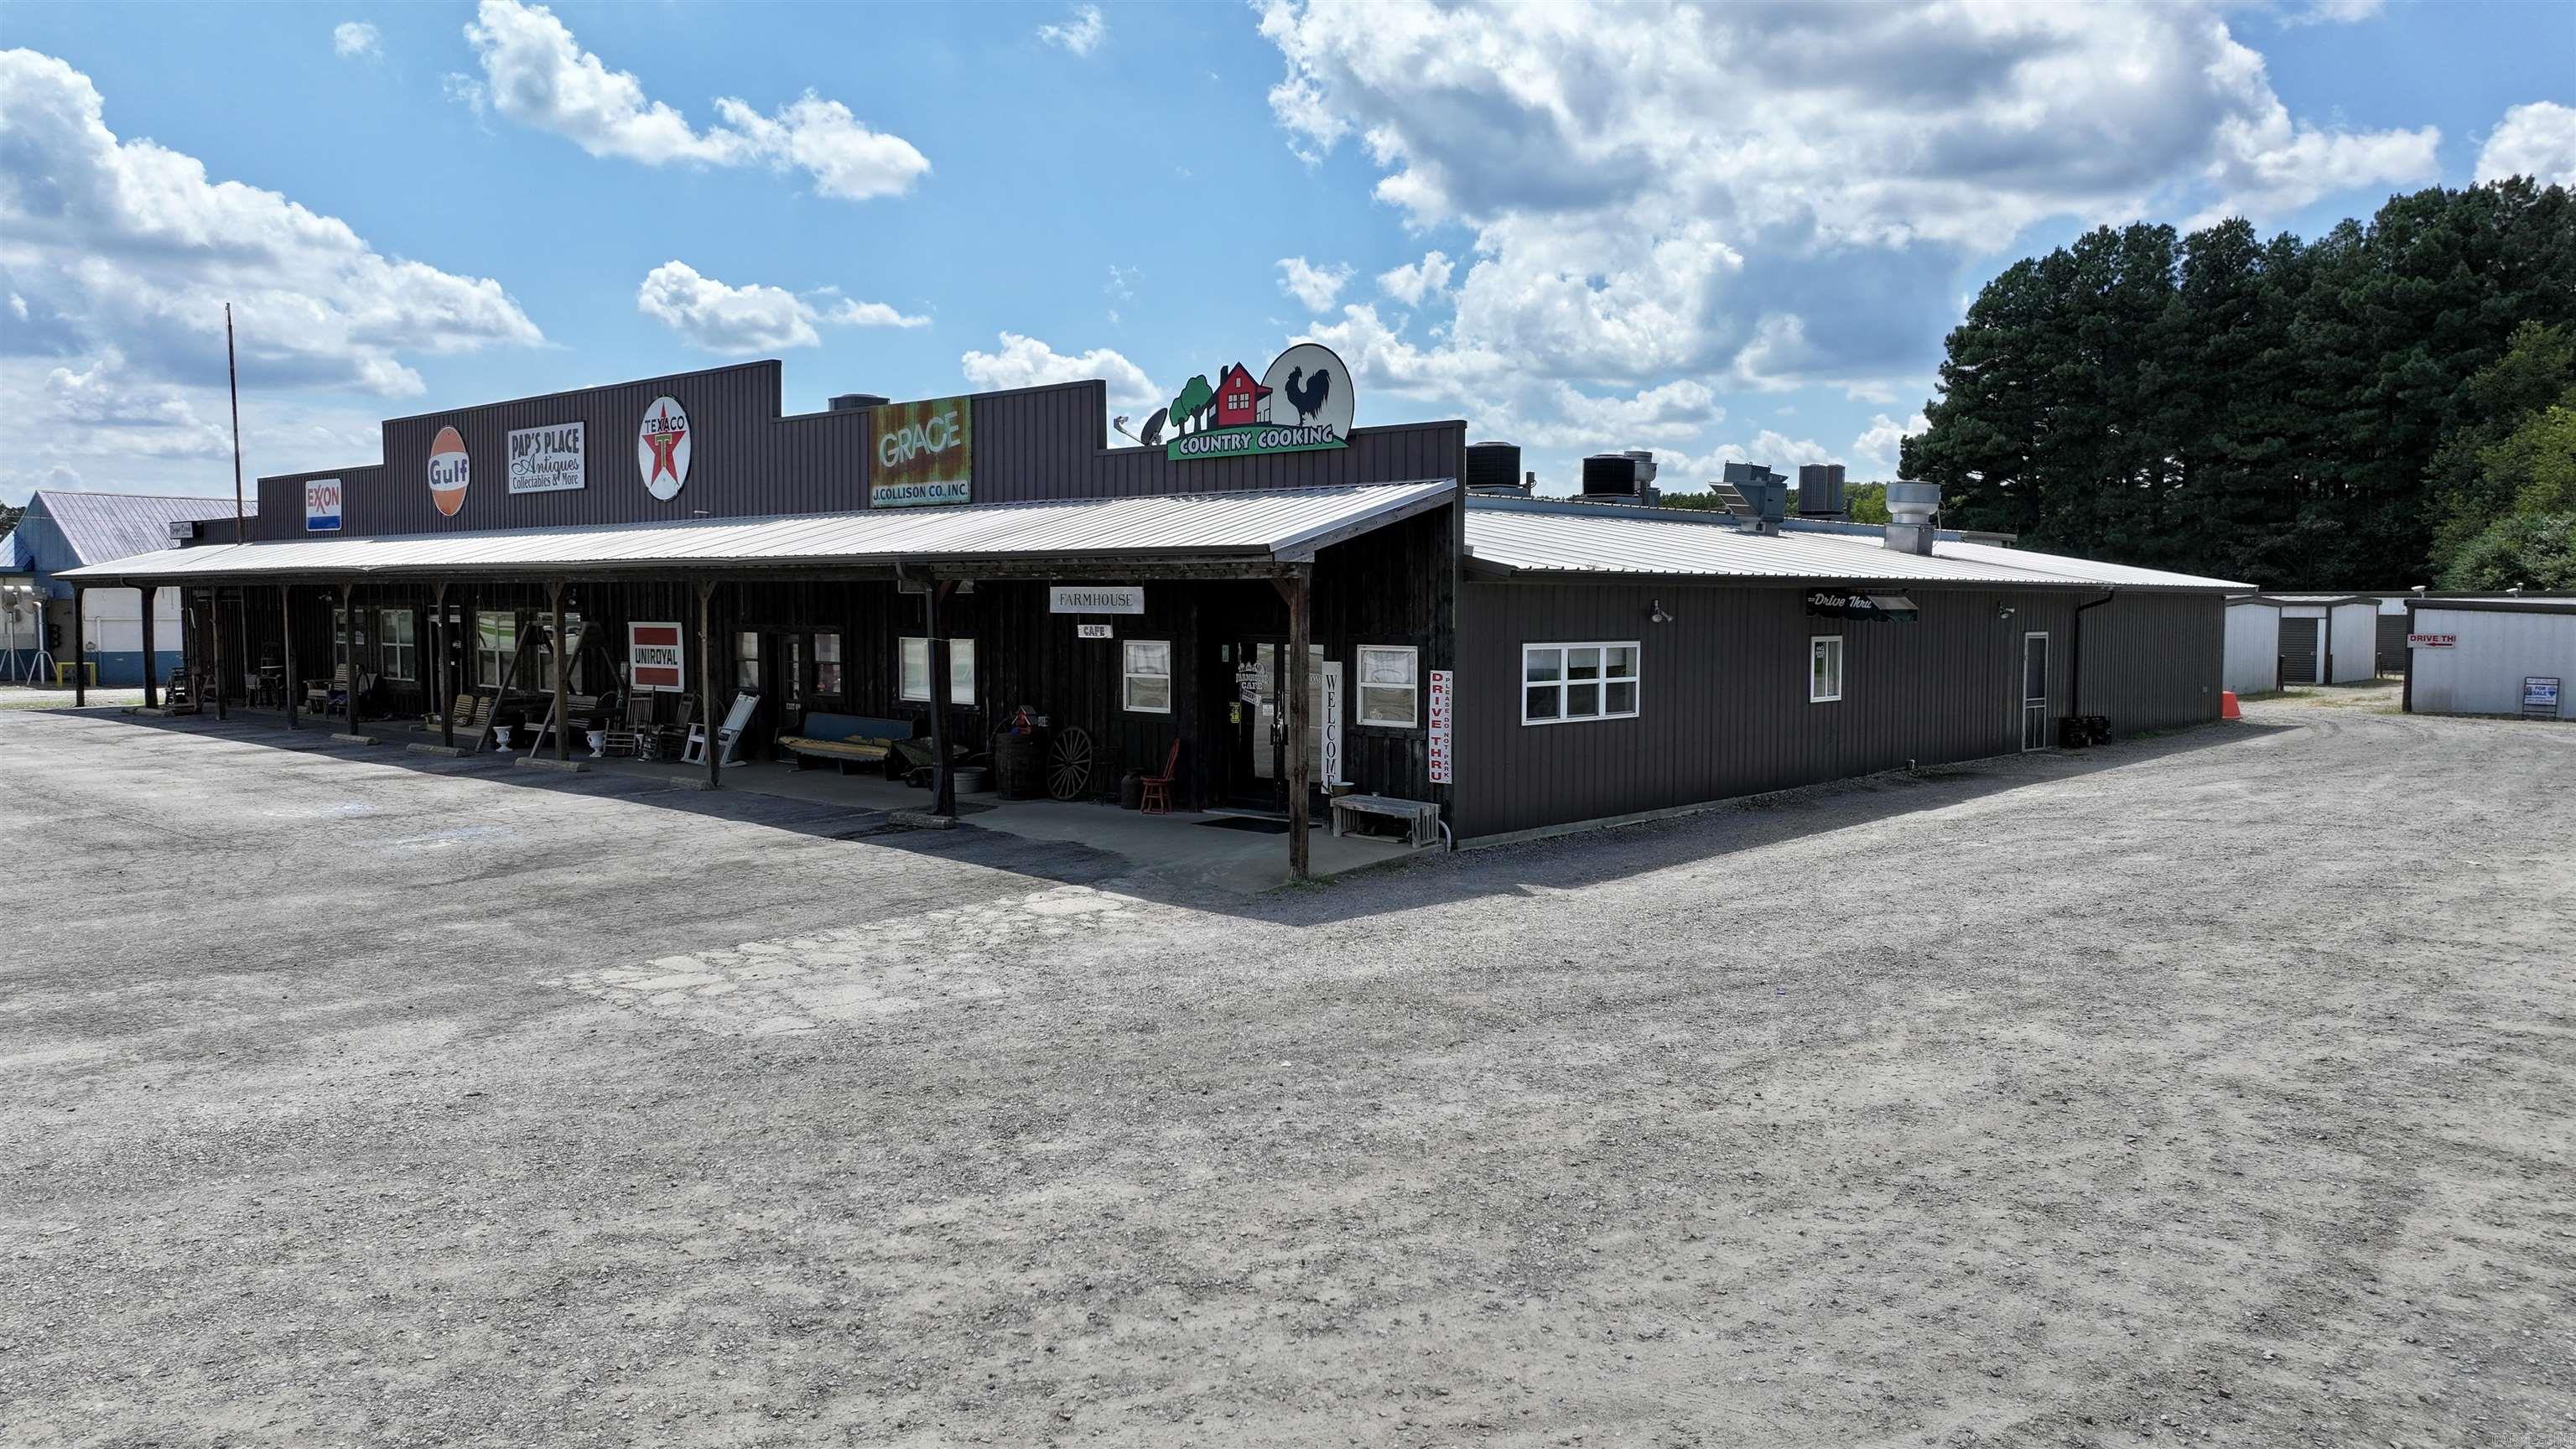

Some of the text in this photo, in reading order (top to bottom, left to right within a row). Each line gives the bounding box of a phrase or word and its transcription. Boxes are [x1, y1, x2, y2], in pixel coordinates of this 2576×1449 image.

[645, 416, 684, 433] TEXACO
[512, 428, 579, 460] PAP'S PLACE
[879, 411, 961, 467] GRACE
[1179, 424, 1334, 454] COUNTRY COOKING
[430, 459, 468, 485] Gulf
[512, 454, 579, 480] Antiques
[512, 473, 578, 489] Collectables & More
[308, 484, 339, 514] EXXON
[1060, 593, 1133, 606] FARMHOUSE
[1815, 593, 1872, 609] Drive Thru
[1083, 626, 1105, 636] CAFE
[635, 648, 678, 665] UNIROYAL
[1326, 674, 1337, 793] WELCOME
[1431, 673, 1443, 781] DRIVE THRU
[1444, 718, 1450, 729] DO
